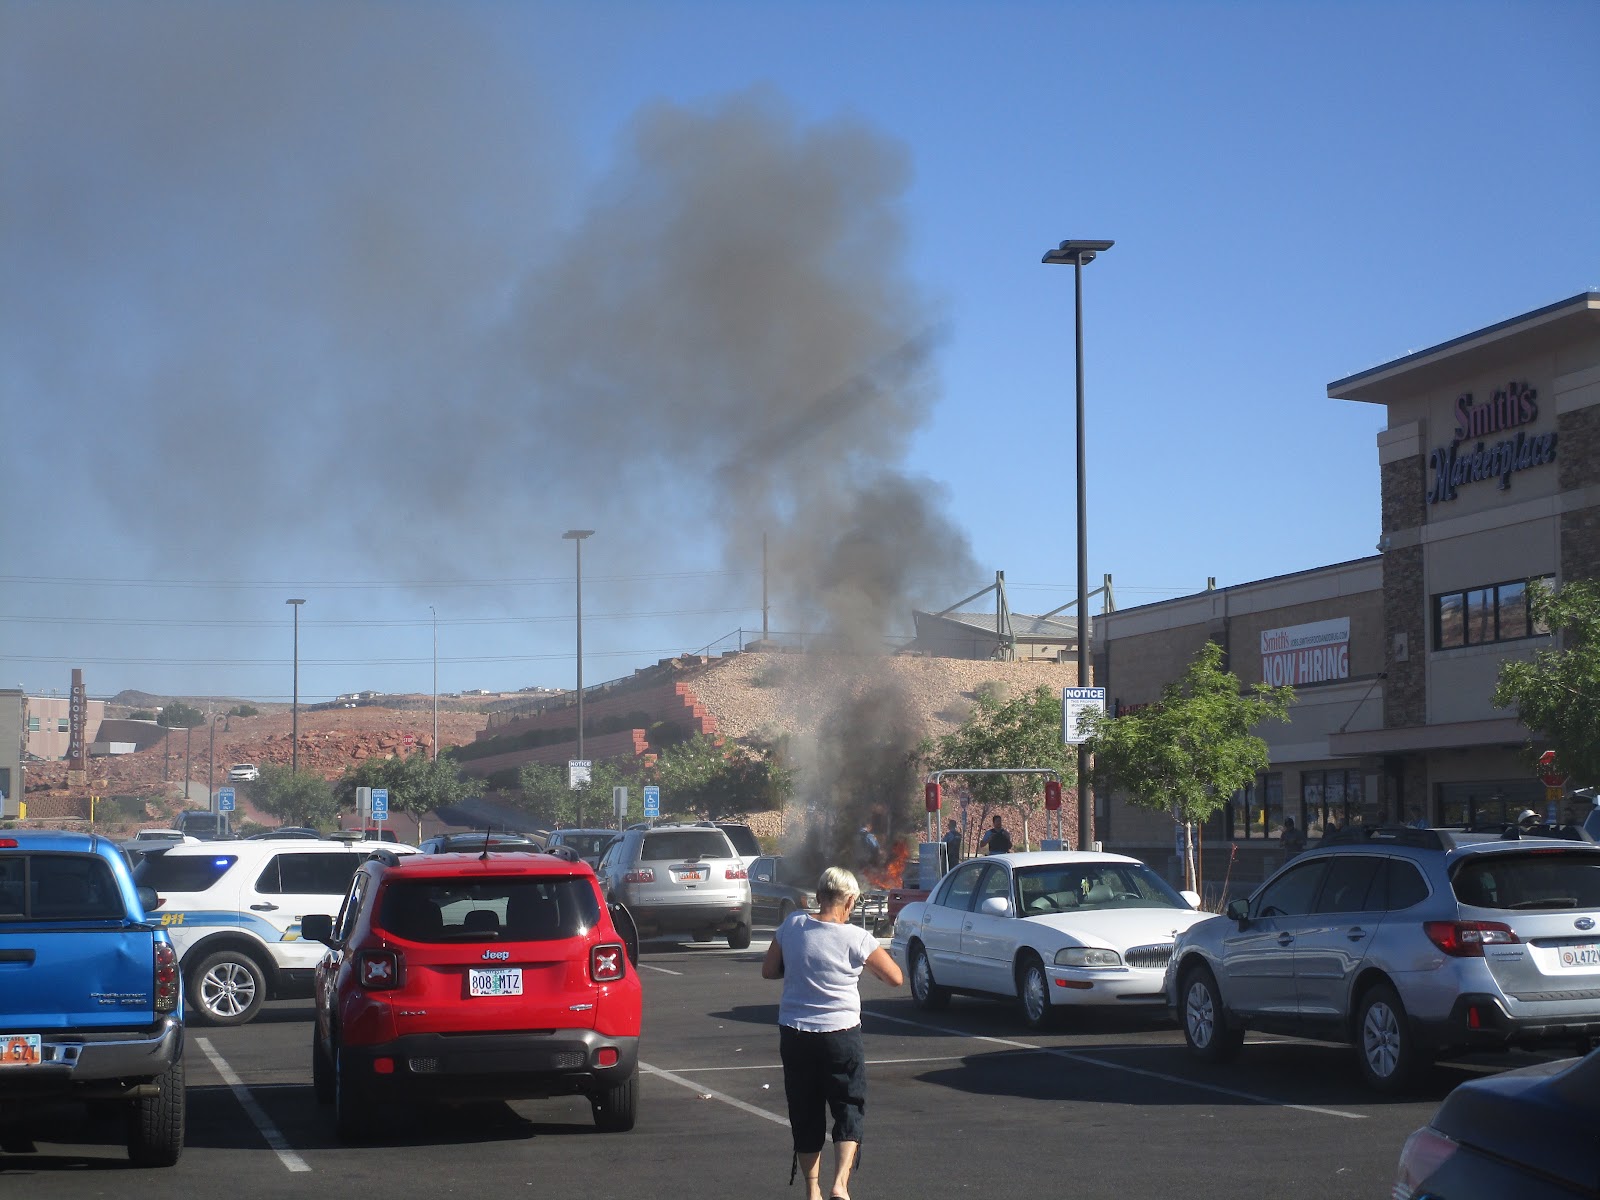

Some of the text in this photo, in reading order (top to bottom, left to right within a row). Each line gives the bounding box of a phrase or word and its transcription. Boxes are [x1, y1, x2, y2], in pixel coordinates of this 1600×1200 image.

[1454, 381, 1538, 441] Smith's
[1426, 432, 1557, 504] Marketplace
[1263, 631, 1290, 652] Smith's
[1263, 645, 1349, 687] NOW HIRING
[1066, 689, 1104, 698] NOTICE
[72, 686, 80, 758] CROSSING
[160, 913, 185, 926] 911
[482, 949, 510, 960] Jeep
[472, 974, 520, 989] 808 MTZ
